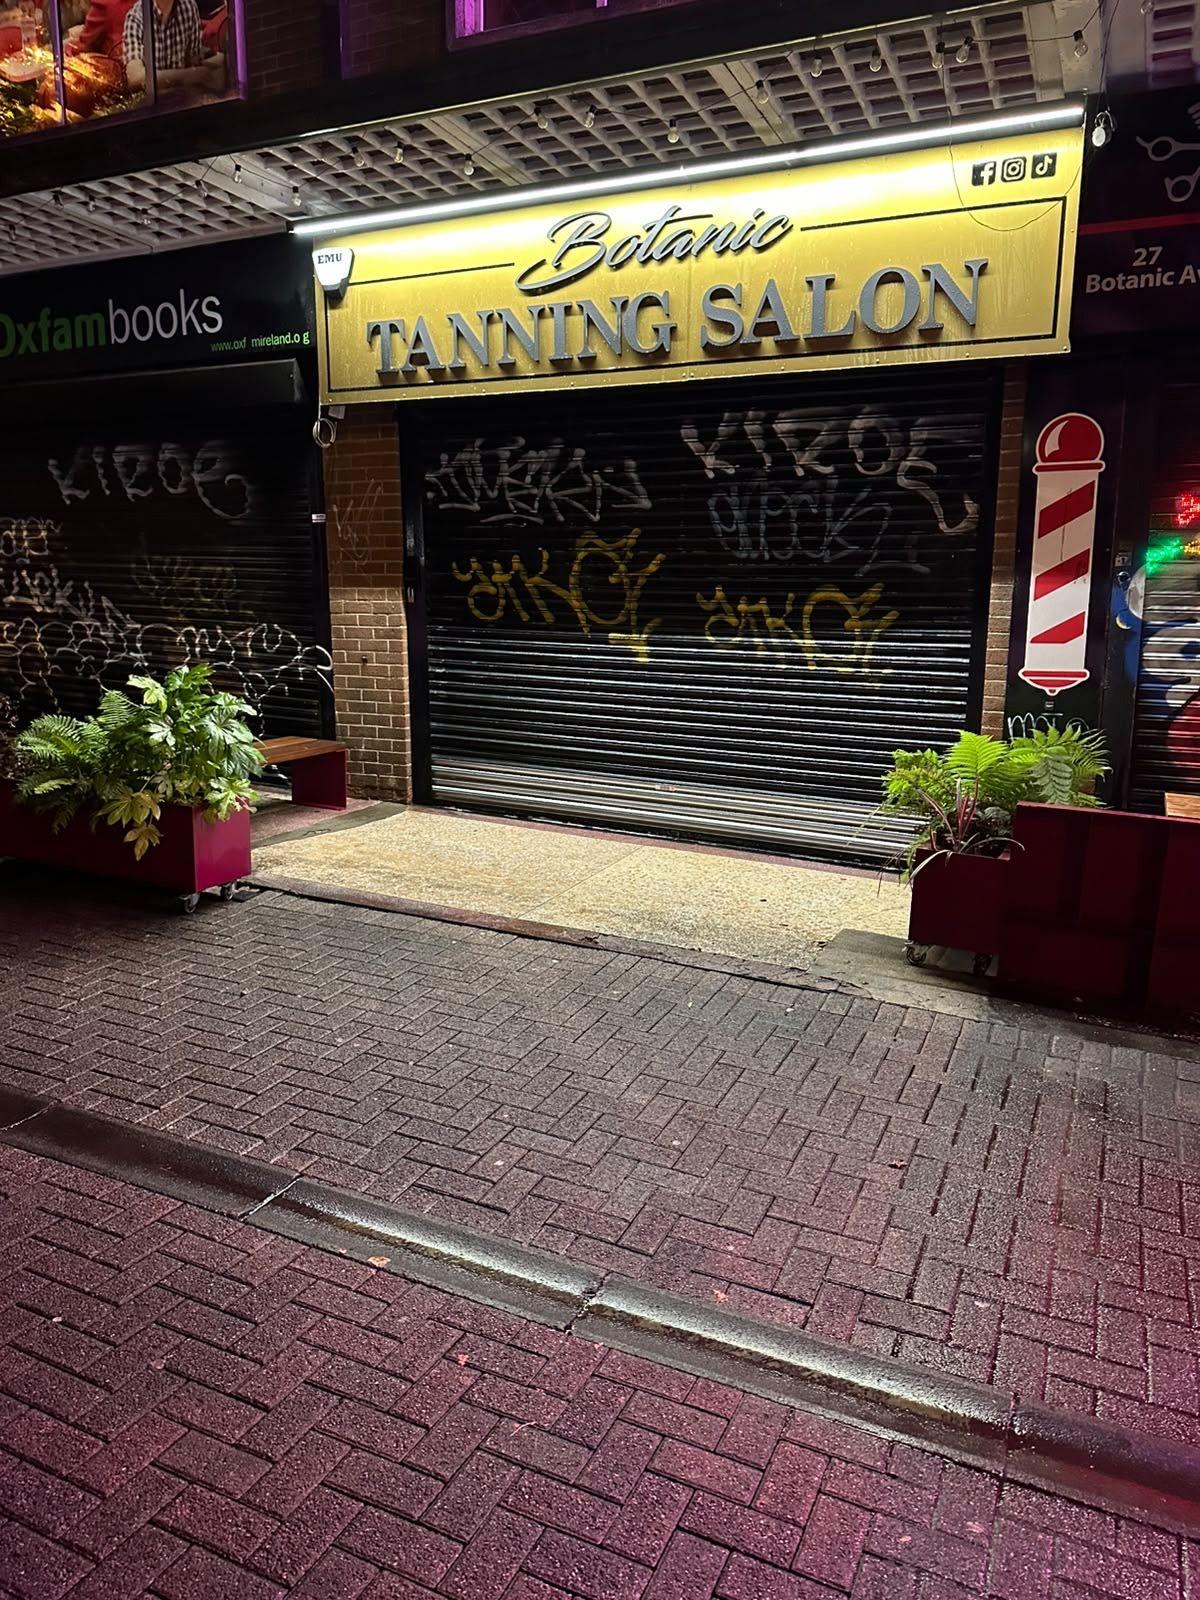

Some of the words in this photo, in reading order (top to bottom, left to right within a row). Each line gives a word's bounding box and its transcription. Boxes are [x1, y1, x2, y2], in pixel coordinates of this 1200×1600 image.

[317, 253, 342, 264] EMU
[515, 205, 793, 294] Botanic
[1132, 246, 1163, 267] 27
[1085, 268, 1175, 293] Botanic
[1178, 265, 1200, 285] A
[367, 290, 677, 375] TANNING
[700, 259, 989, 350] SALON
